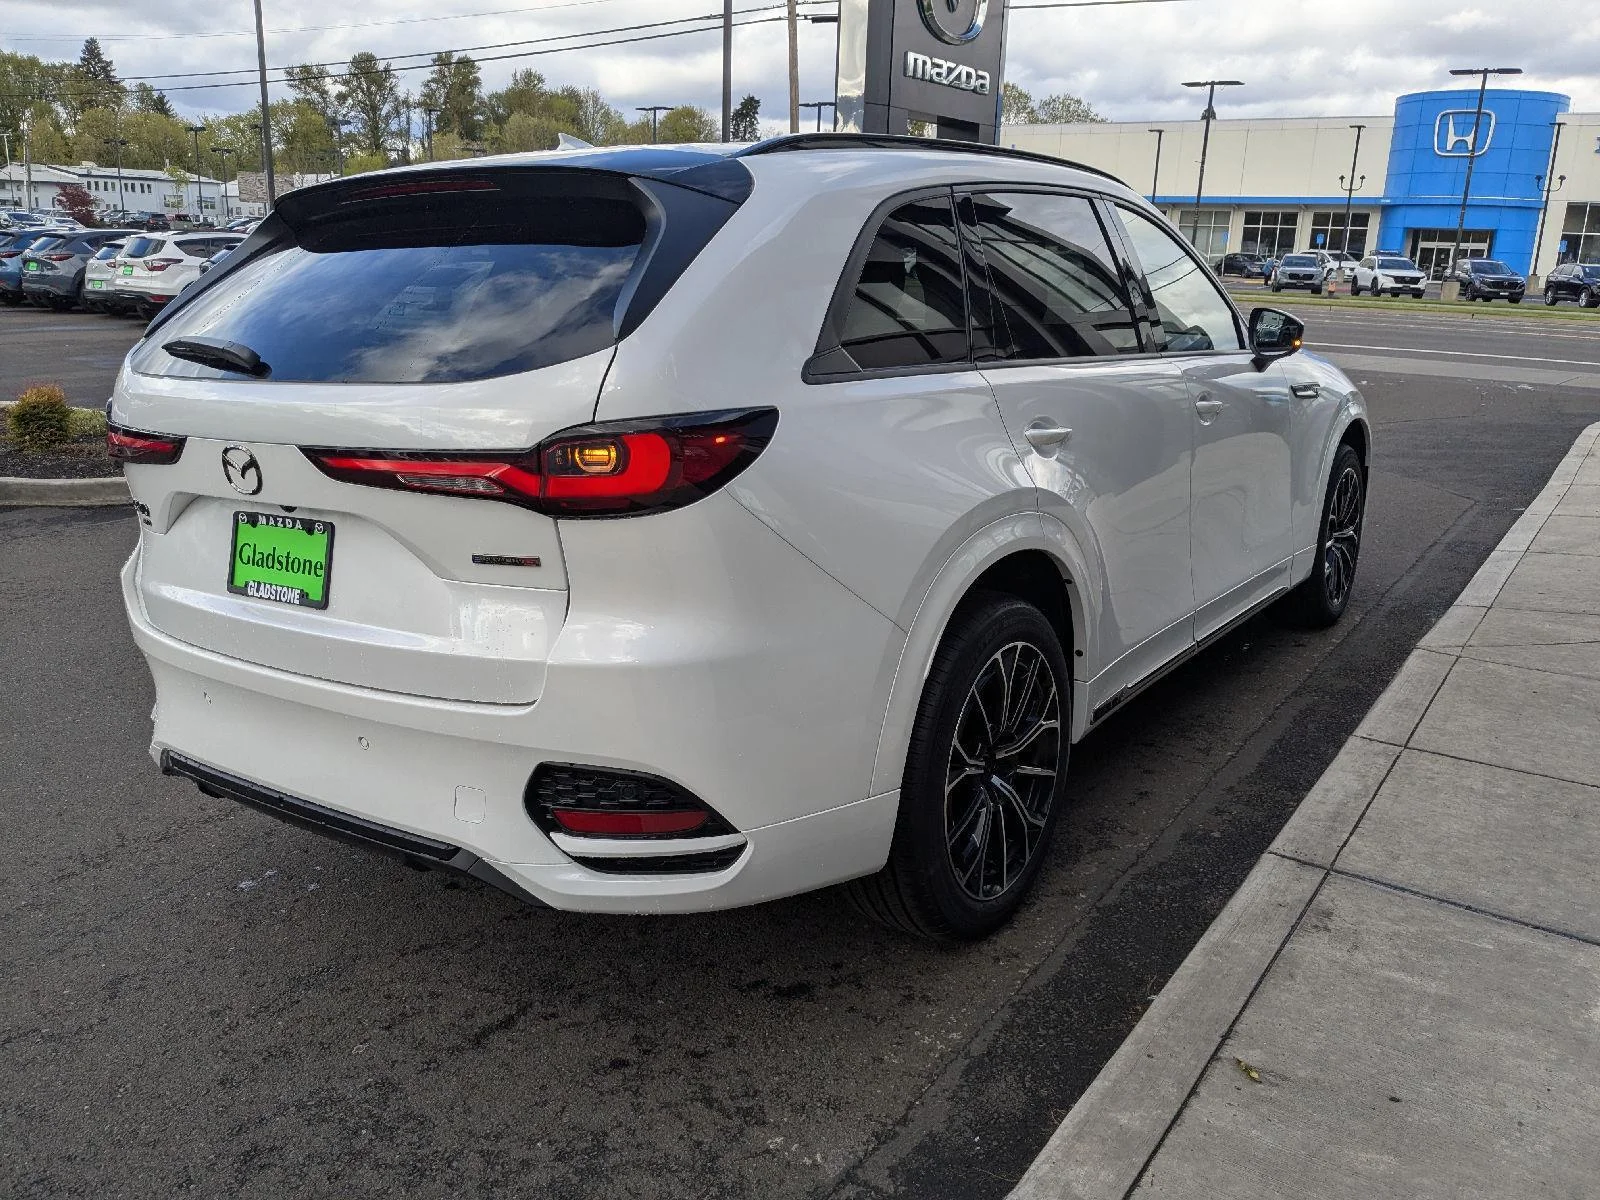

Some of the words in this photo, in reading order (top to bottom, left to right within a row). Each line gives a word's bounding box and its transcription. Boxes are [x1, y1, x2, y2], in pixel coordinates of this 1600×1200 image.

[258, 515, 302, 530] MAZDA
[238, 542, 324, 577] Gladstone
[247, 581, 301, 604] GLADSTONE
